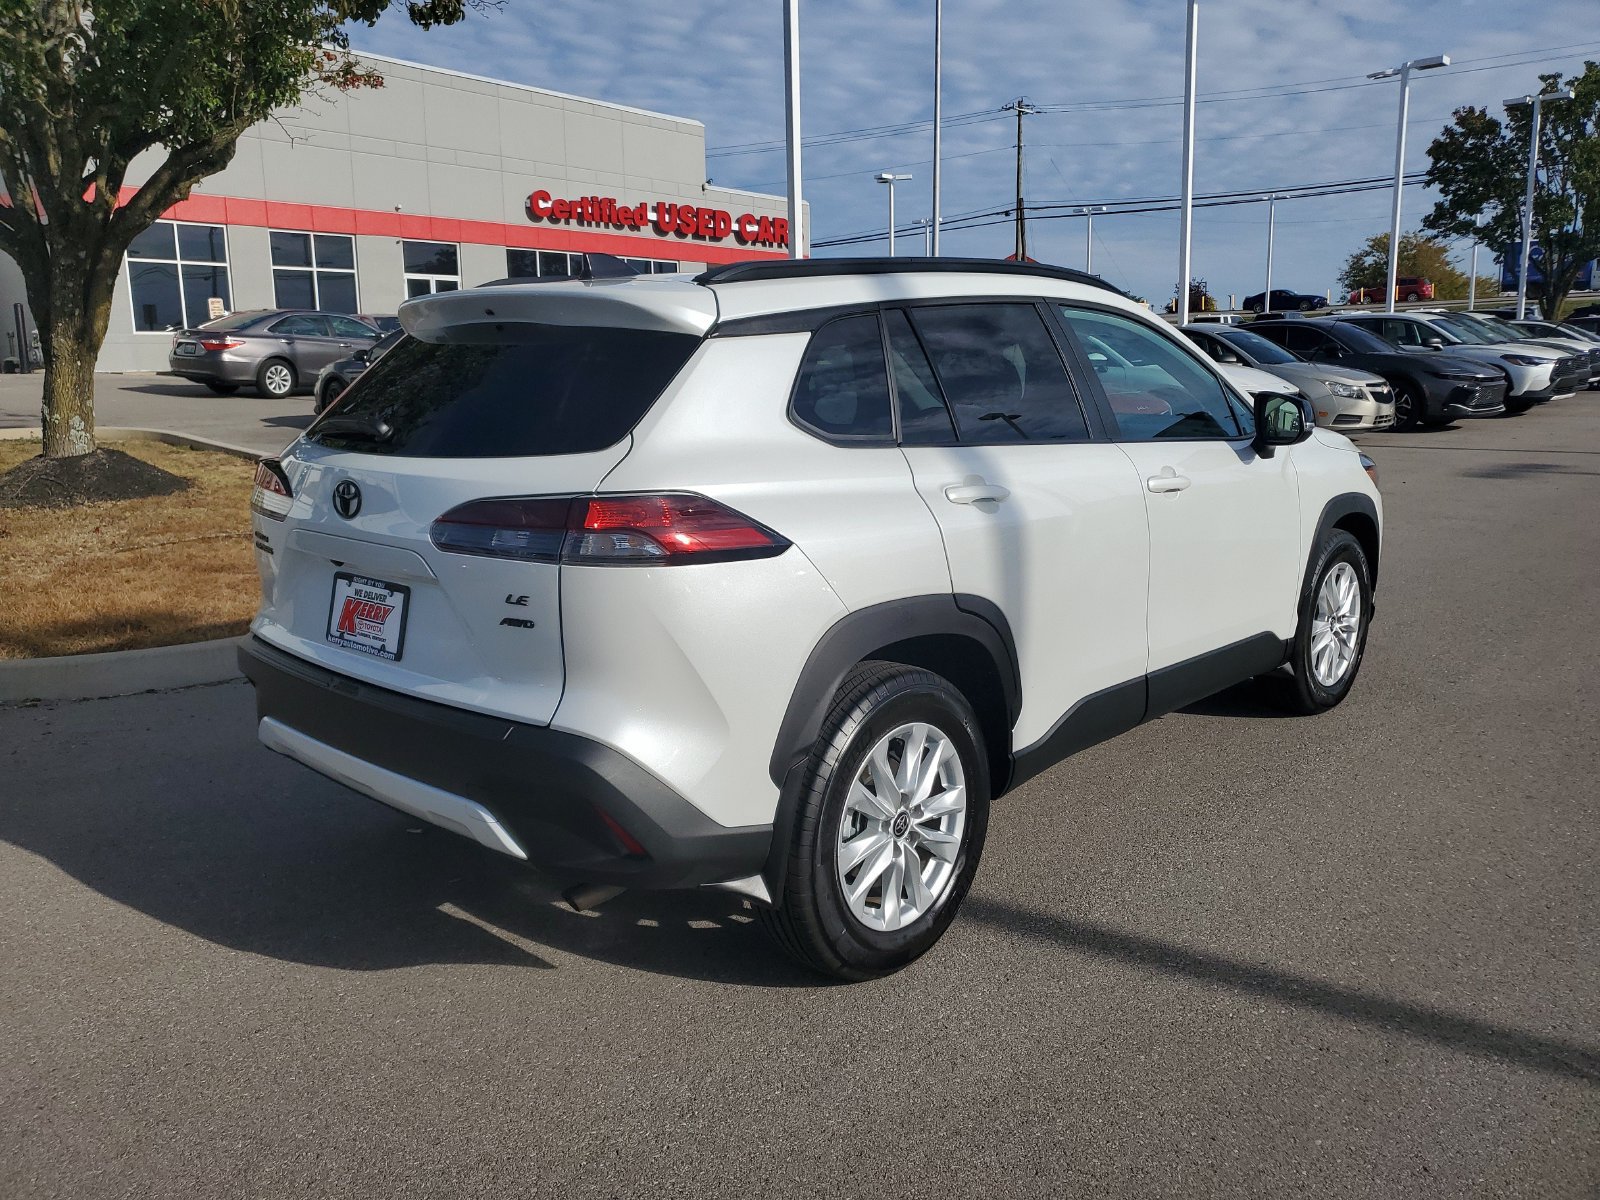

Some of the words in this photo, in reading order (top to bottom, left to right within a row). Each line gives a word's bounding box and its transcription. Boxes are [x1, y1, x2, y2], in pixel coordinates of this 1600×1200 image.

[528, 189, 649, 227] Certified
[656, 201, 732, 239] USED
[740, 213, 789, 244] CAR
[354, 588, 363, 597] WE
[363, 591, 388, 603] DELIVER
[504, 593, 530, 606] LE
[337, 597, 392, 636] KERRY
[364, 622, 382, 633] TOYOTA
